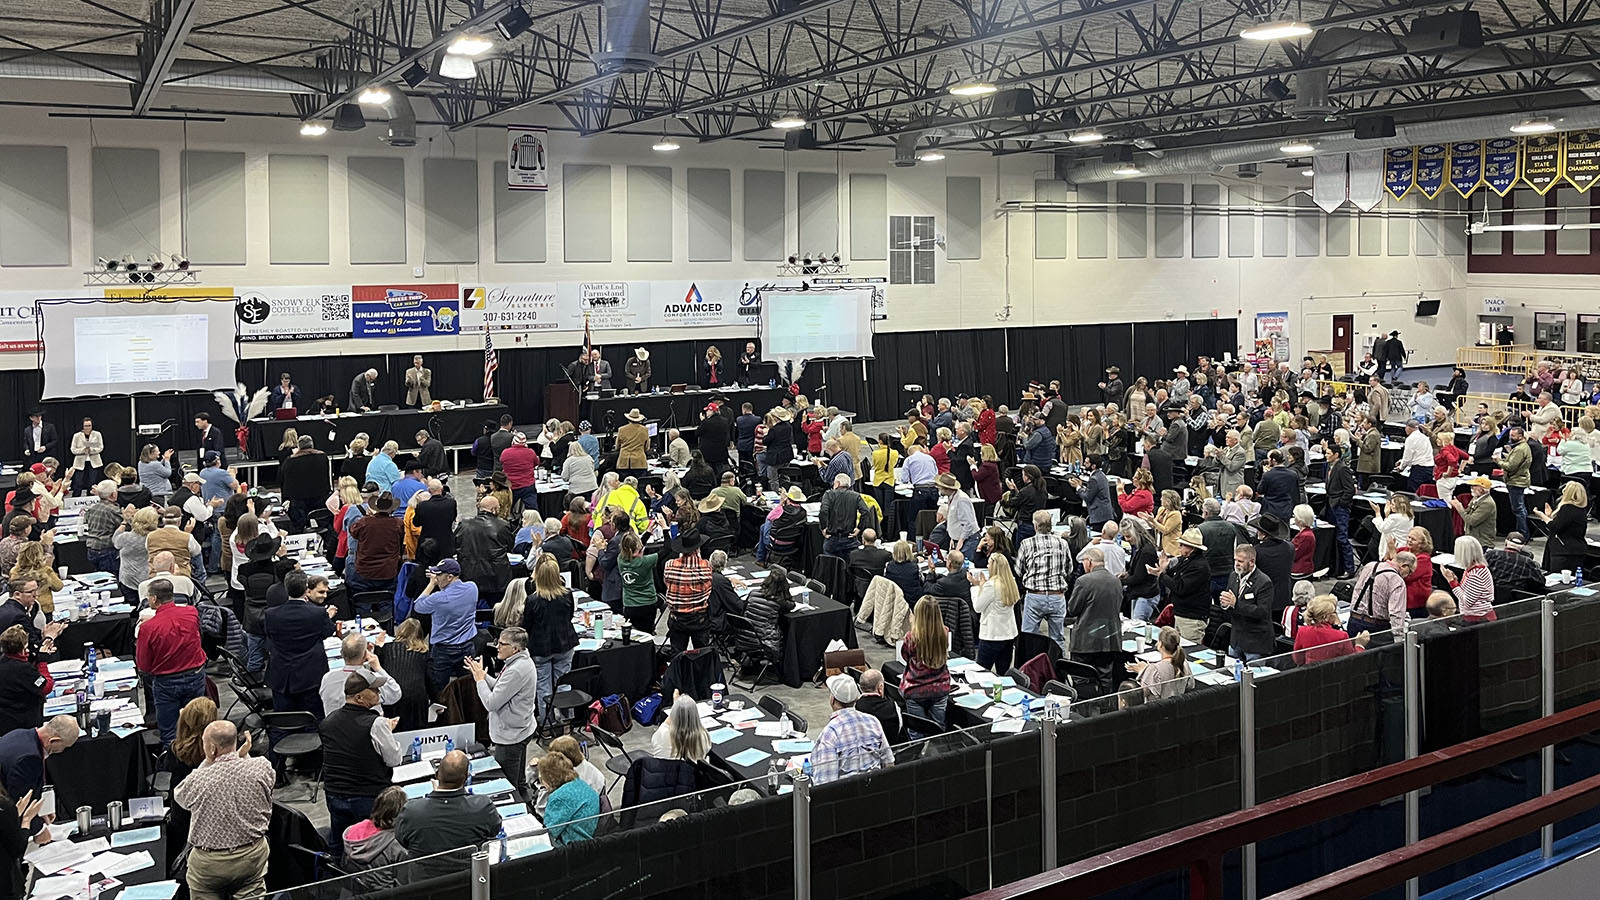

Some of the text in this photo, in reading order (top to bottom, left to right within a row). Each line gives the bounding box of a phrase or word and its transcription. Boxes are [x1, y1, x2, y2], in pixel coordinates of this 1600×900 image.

[307, 298, 320, 306] ELK
[488, 287, 556, 310] Signature
[664, 304, 722, 313] ADVANCED
[483, 312, 536, 321] 307-631-2240
